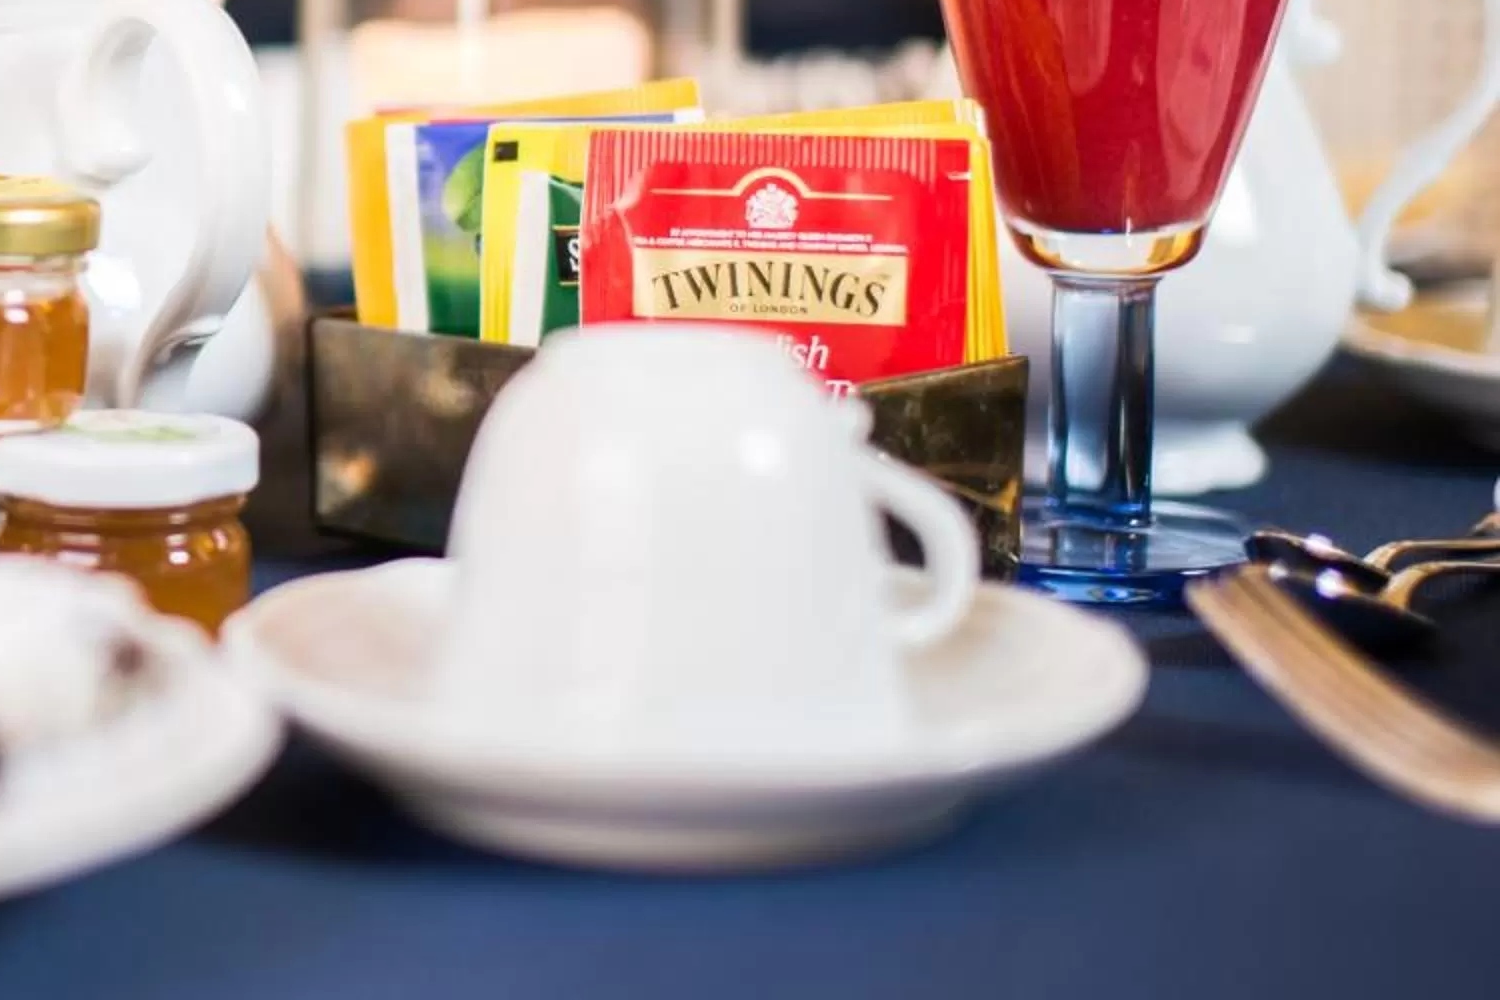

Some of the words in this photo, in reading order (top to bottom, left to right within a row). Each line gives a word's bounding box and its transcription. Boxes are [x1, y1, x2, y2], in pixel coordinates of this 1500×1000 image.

[651, 260, 886, 317] TWININGS
[729, 303, 747, 314] OF
[752, 304, 809, 315] LONDON
